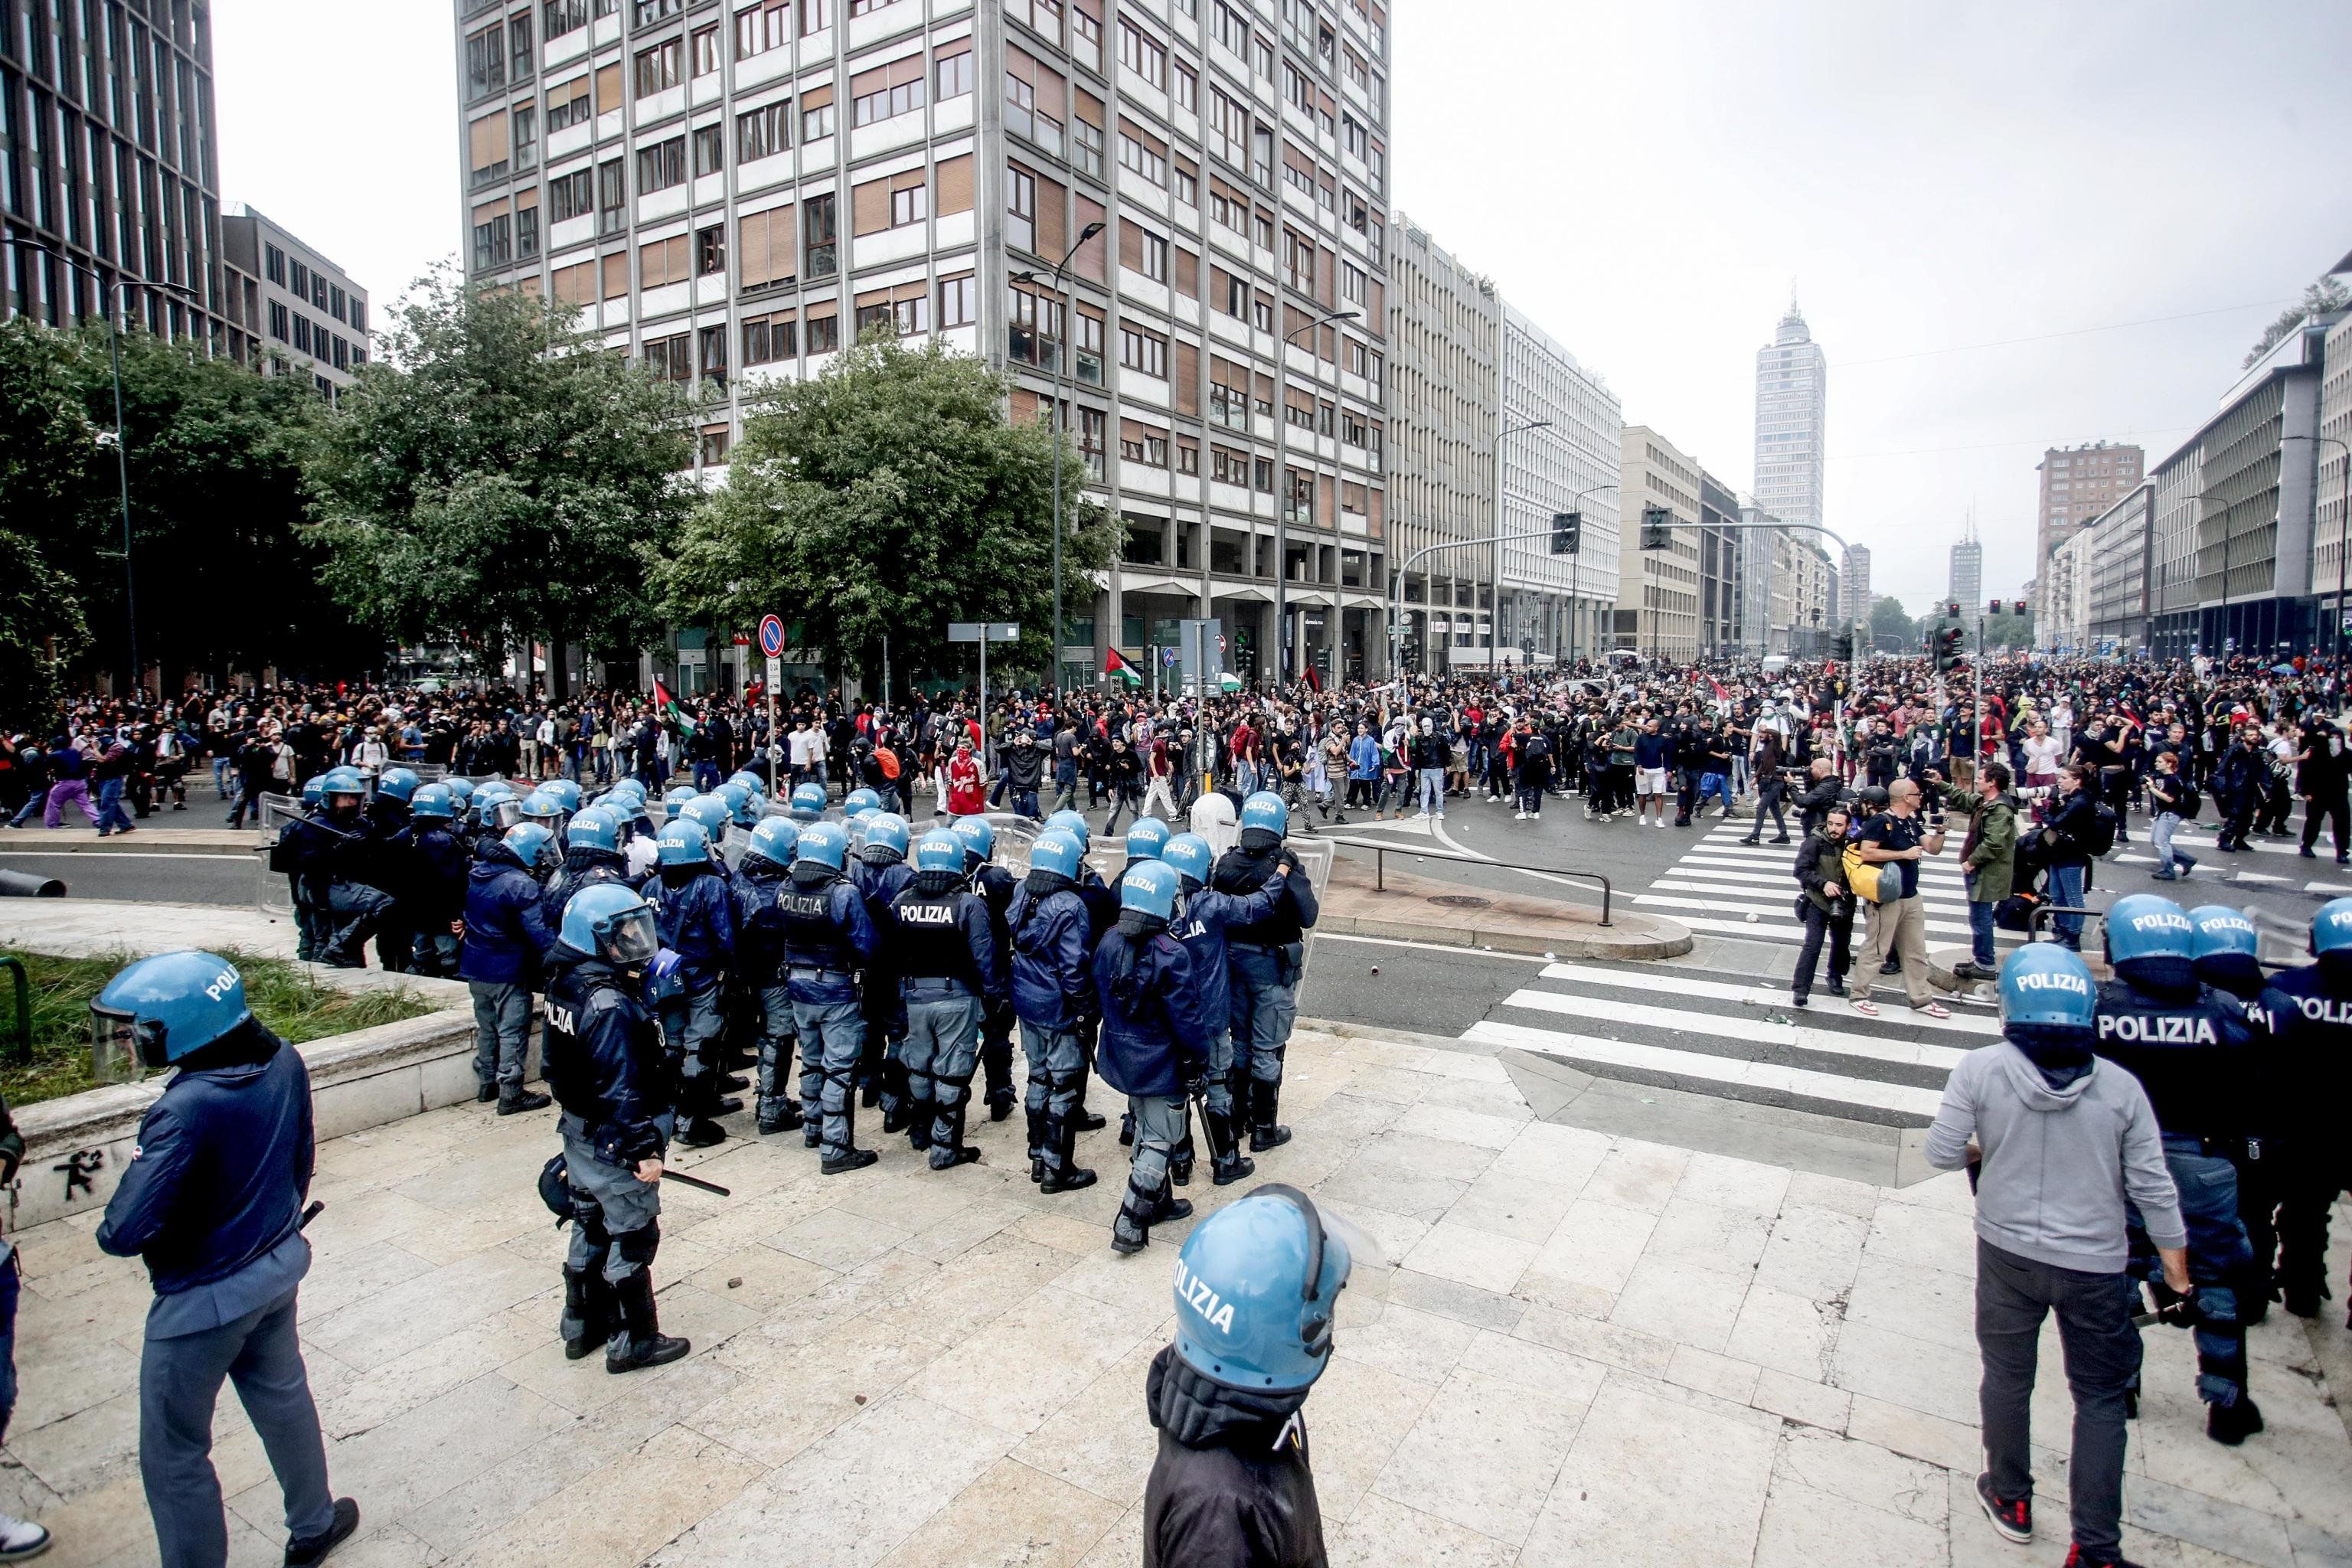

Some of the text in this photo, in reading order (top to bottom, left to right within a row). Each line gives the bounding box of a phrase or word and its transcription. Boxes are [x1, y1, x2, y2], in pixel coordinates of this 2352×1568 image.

[793, 792, 818, 802] POLIZIA
[1244, 802, 1276, 814] POLIZIA
[569, 821, 600, 832] POLIZIA
[869, 820, 900, 833] POLIZIA
[951, 824, 981, 837] POLIZIA
[1128, 831, 1159, 843] POLIZIA
[920, 844, 952, 854] POLIZIA
[1164, 844, 1197, 858] POLIZIA
[1122, 877, 1156, 894] POLIZIA
[777, 893, 823, 915] POLIZIA
[900, 905, 953, 924] POLIZIA
[2132, 913, 2192, 933] POLIZIA
[2200, 918, 2253, 934] POLIZIA
[2015, 973, 2087, 995] POLIZIA
[2098, 1015, 2217, 1044] POLIZIA
[1174, 1258, 1235, 1334] OLIZIA
